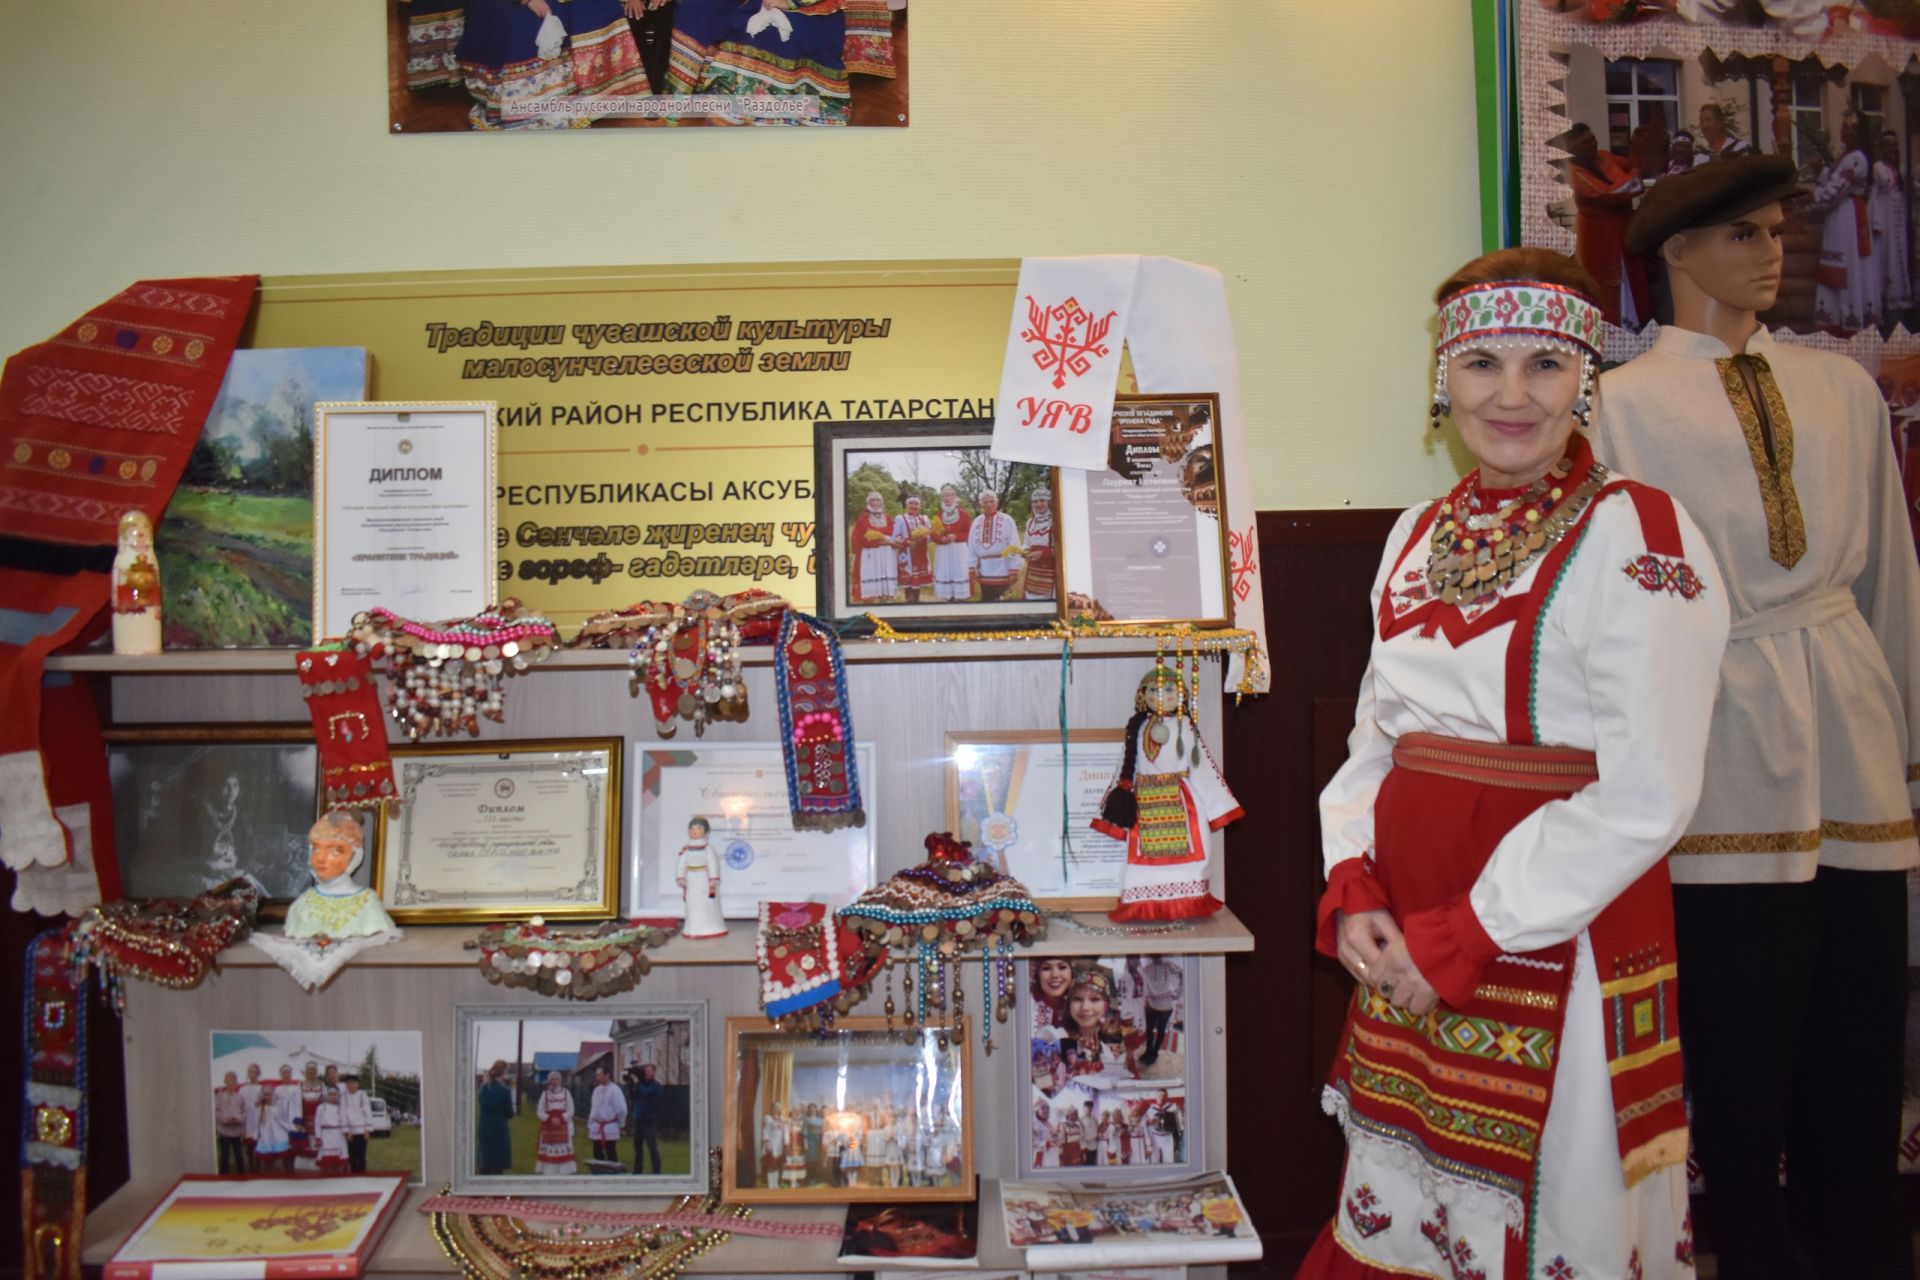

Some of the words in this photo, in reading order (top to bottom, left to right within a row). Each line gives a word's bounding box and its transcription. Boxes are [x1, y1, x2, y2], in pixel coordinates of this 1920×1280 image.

[510, 99, 571, 113] Ансамбль
[575, 97, 626, 116] русской
[629, 97, 691, 116] народной
[694, 101, 731, 112] песни
[425, 321, 567, 353] Традиции
[572, 316, 732, 349] чувашской
[737, 318, 892, 345] культуры
[462, 349, 754, 382] малосунчелеевской
[758, 351, 852, 372] земли
[551, 401, 642, 425] РАЙОН
[652, 400, 832, 423] РЕСПУБЛИКА
[841, 398, 995, 420] ТАТАРСТАН
[1017, 397, 1093, 433] УЯВ
[369, 467, 443, 484] ДИПЛОМ
[497, 481, 713, 505] РЕСПУБЛИКАСЫ
[722, 480, 815, 500] АКСУБ
